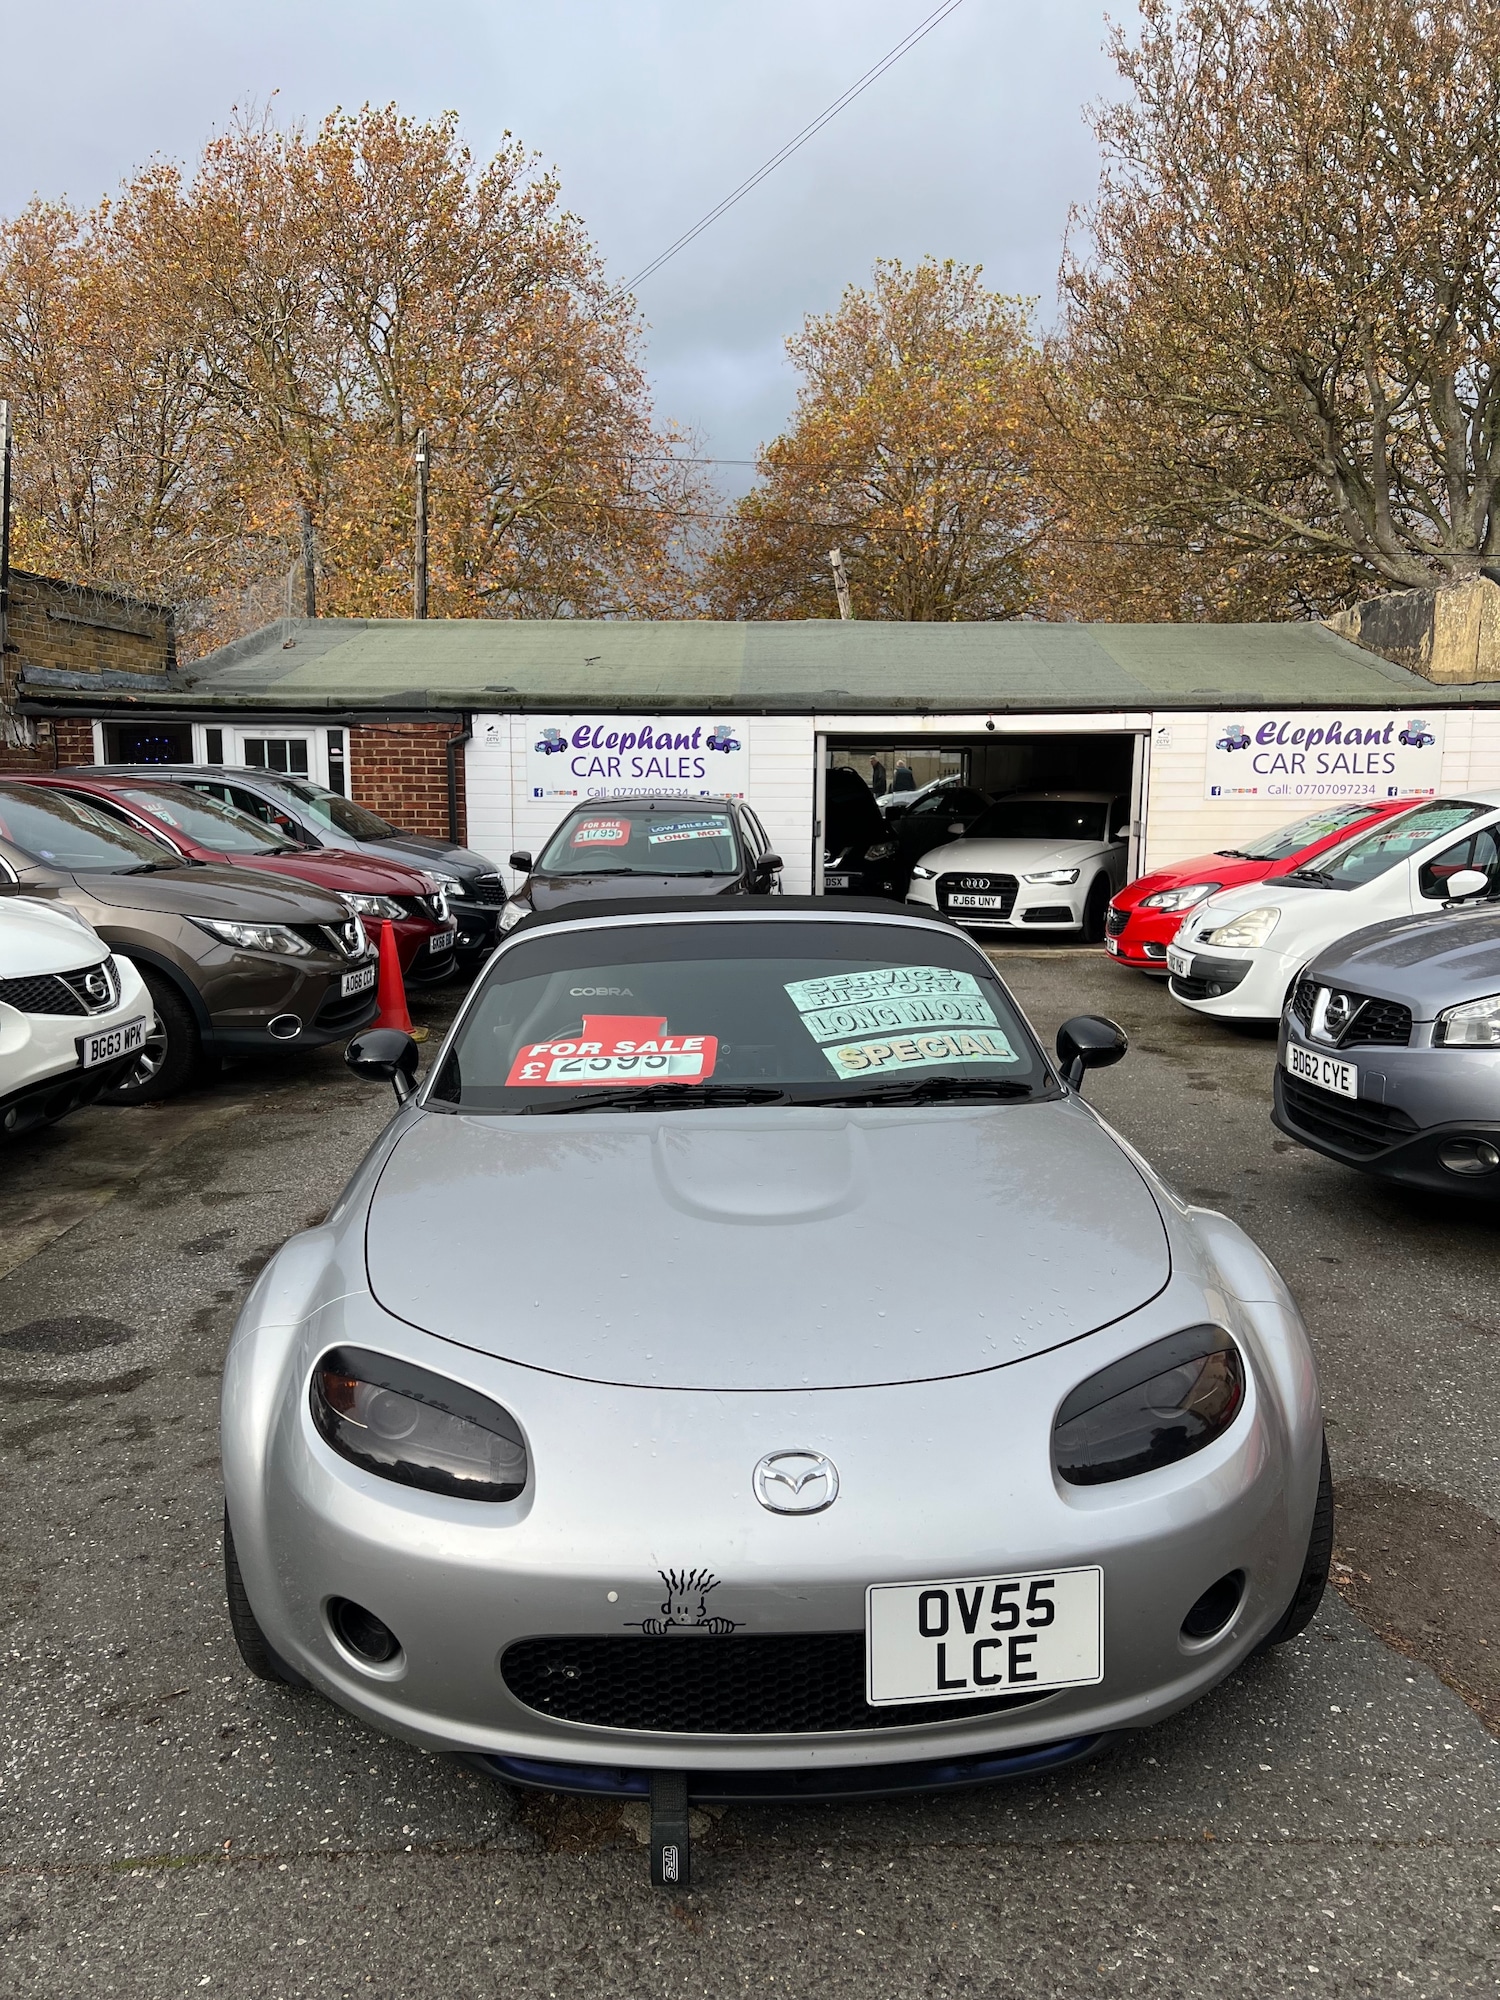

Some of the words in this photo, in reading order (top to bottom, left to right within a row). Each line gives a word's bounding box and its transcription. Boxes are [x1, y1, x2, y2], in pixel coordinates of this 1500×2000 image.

[571, 725, 702, 755] Elephant
[1255, 720, 1394, 751] Elephant
[571, 757, 621, 778] CAR
[632, 757, 706, 778] SALES
[1252, 753, 1306, 775] CAR
[1316, 752, 1396, 775] SALES
[587, 787, 610, 798] Call:
[1267, 784, 1292, 795] Call:
[1295, 784, 1376, 795] 07707097234
[651, 825, 675, 833] LOW
[677, 821, 723, 830] MILEAGE
[657, 833, 690, 842] LONG
[697, 829, 723, 837] MOT
[1407, 831, 1433, 839] MOT
[825, 878, 843, 887] DSX
[953, 896, 976, 906] RJ66
[978, 897, 997, 906] UNY
[569, 987, 634, 997] COBRA
[802, 967, 958, 995] SERVICE
[807, 978, 961, 1006] HISTORY
[810, 1003, 901, 1036] LONG
[91, 1032, 121, 1061] BG63
[124, 1023, 142, 1050] WPK
[527, 1042, 603, 1057] FOR
[612, 1037, 706, 1054] SALE
[836, 1034, 1011, 1070] SPECIAL
[518, 1061, 546, 1080] £
[559, 1055, 668, 1073] 2595
[1292, 1048, 1319, 1079] BD62
[1322, 1059, 1350, 1091] CYE
[918, 1578, 1056, 1639] OV55
[936, 1633, 1038, 1691] LCE
